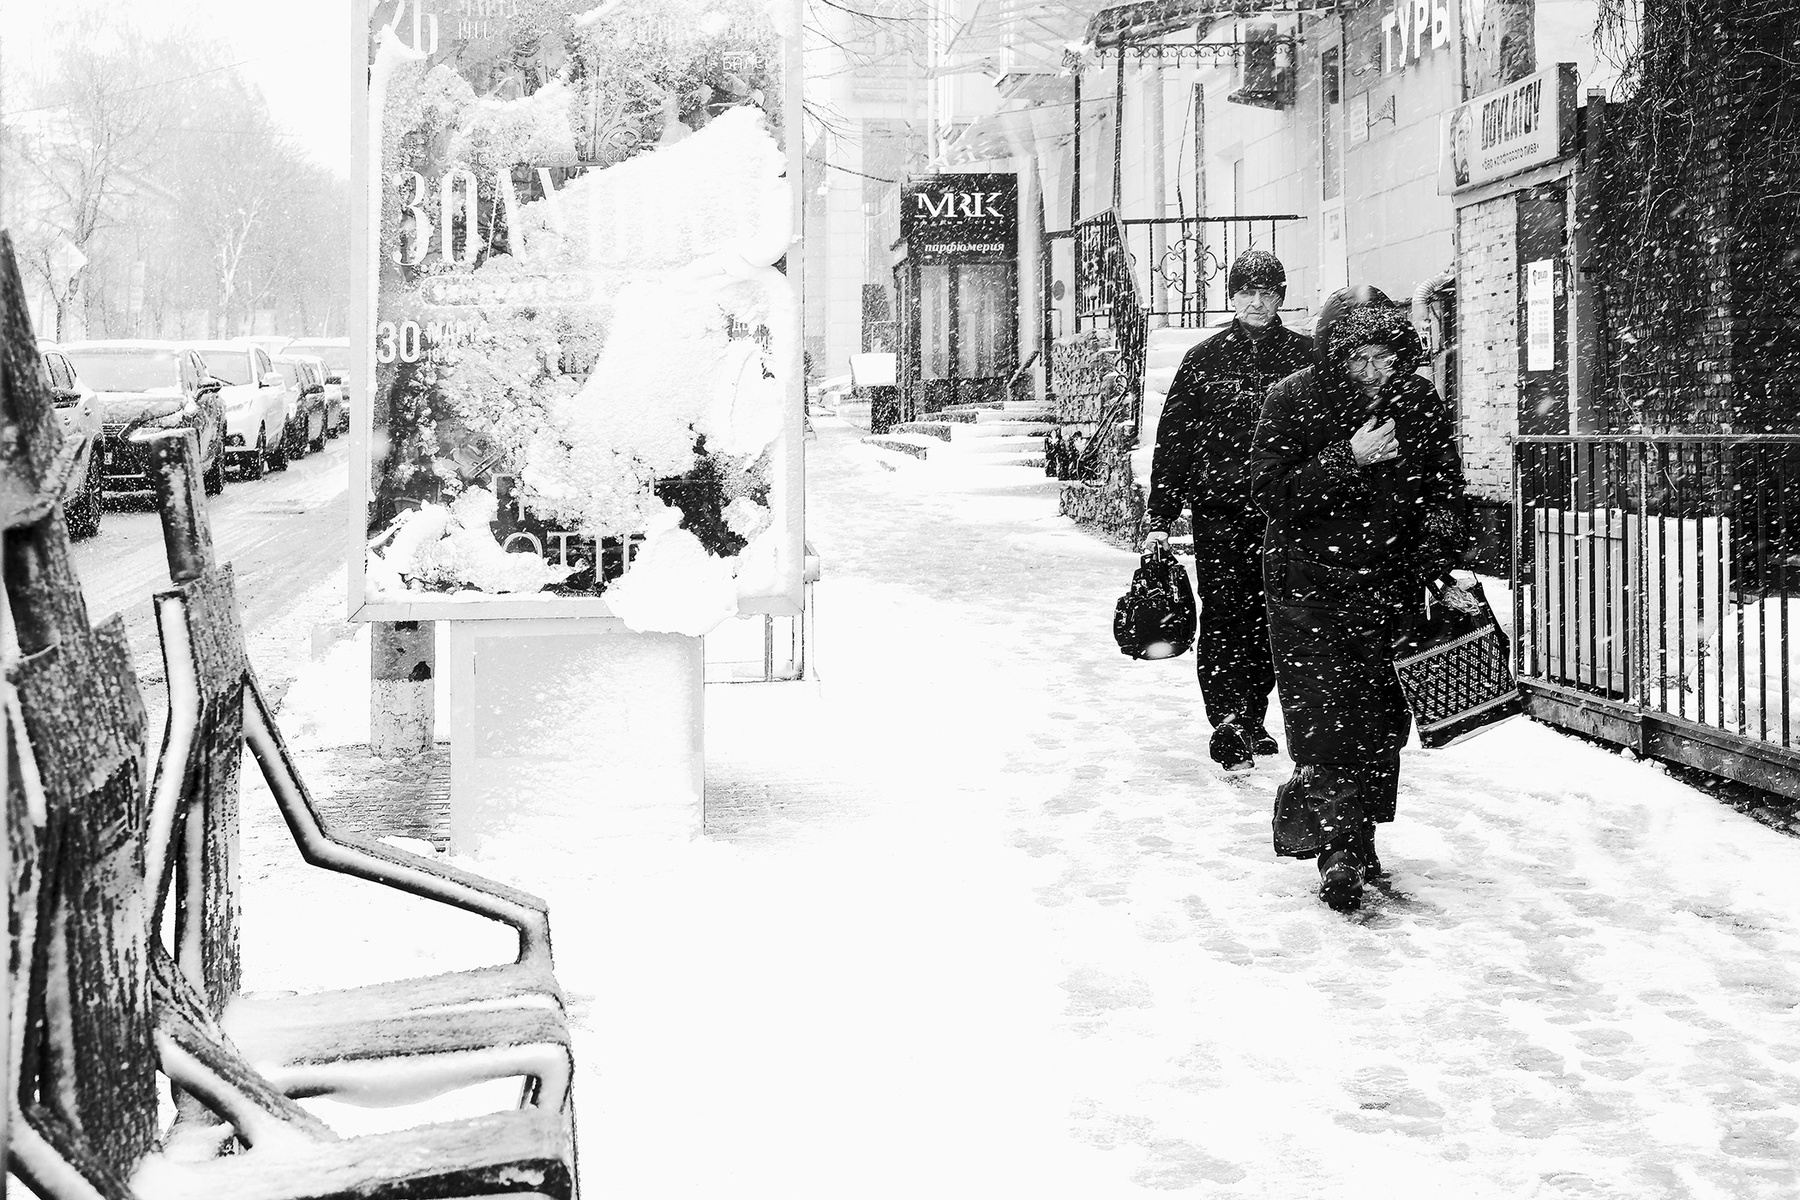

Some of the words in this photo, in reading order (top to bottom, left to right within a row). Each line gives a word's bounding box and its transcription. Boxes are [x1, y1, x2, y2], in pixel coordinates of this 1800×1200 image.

[1381, 0, 1451, 73] ТУРЫ
[914, 191, 1005, 218] MRK
[924, 241, 1005, 254] парфюмерия
[376, 320, 421, 364] 30
[427, 320, 488, 344] МАРТ
